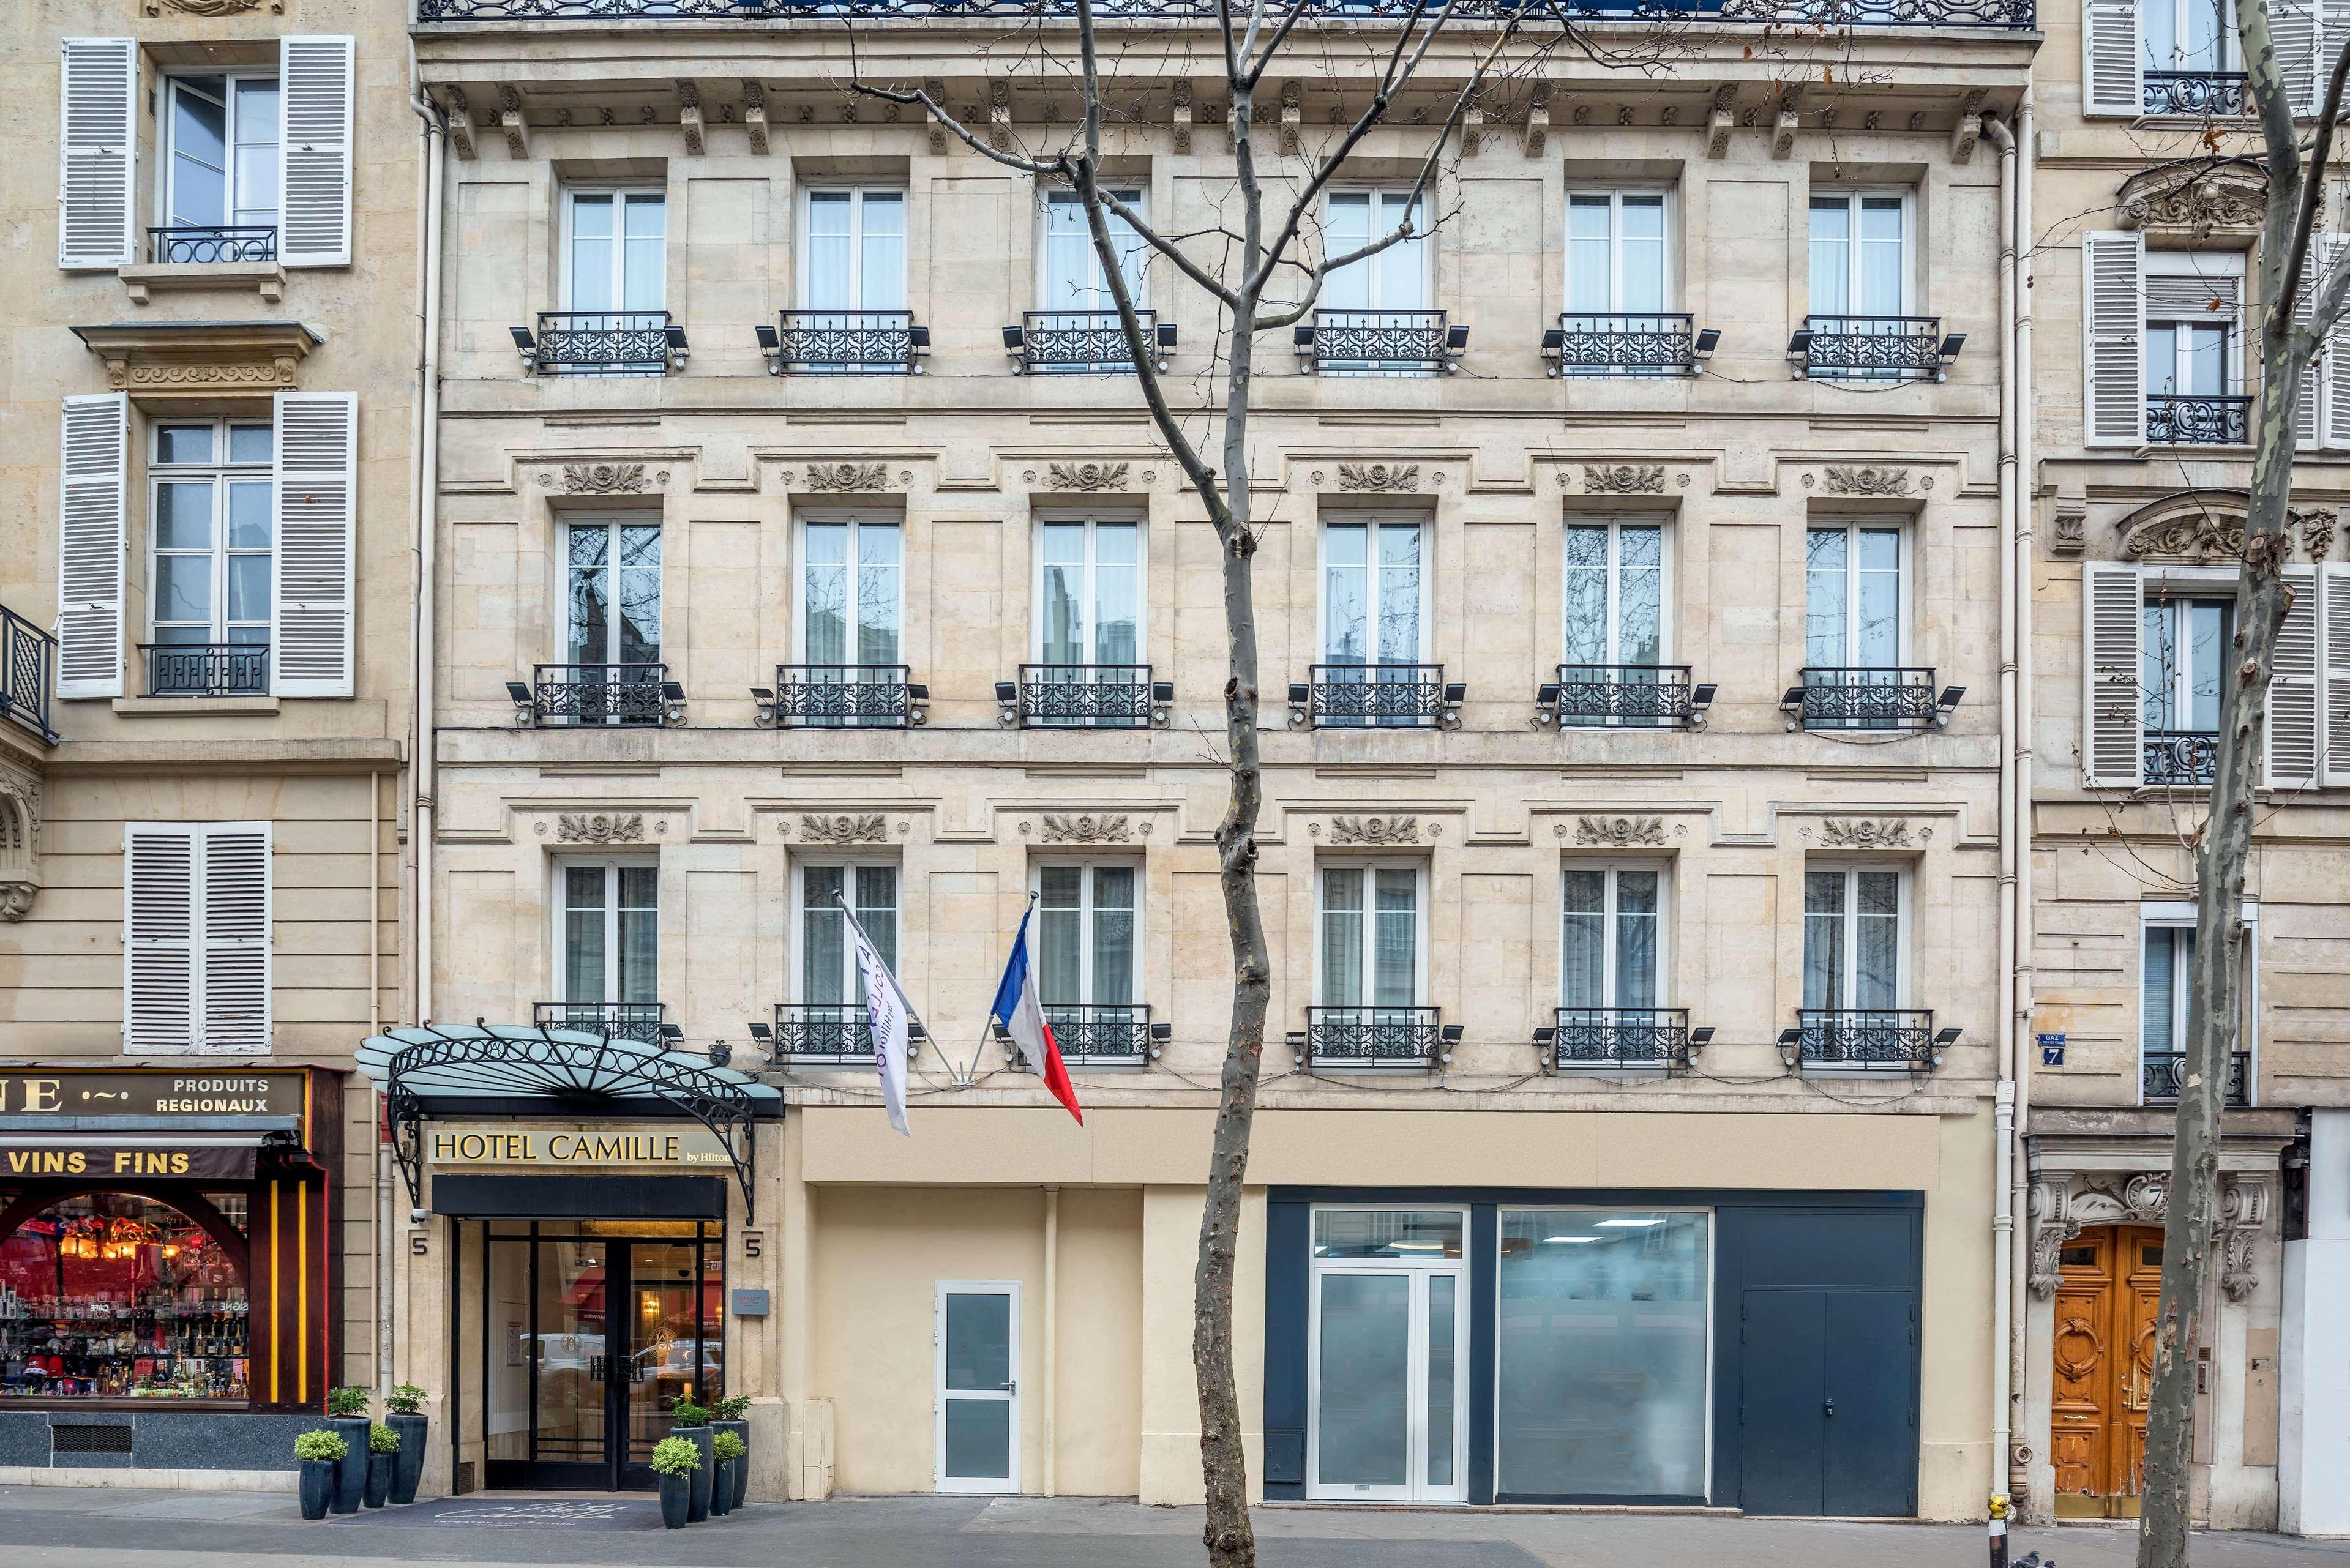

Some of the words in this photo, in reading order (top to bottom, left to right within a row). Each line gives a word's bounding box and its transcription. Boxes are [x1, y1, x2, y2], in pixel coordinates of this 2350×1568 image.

[2049, 1048, 2059, 1064] 7
[174, 1079, 269, 1092] PRODUITS
[0, 1079, 63, 1112] E
[156, 1099, 268, 1112] REGIONAUX
[435, 1134, 538, 1160] HOTEL
[548, 1135, 679, 1160] CAMILLE
[686, 1152, 699, 1164] by
[700, 1152, 732, 1162] Hilton
[8, 1152, 86, 1173] VINS
[114, 1152, 189, 1174] FINS
[2149, 1188, 2162, 1206] 7
[413, 1237, 427, 1255] 5
[746, 1239, 760, 1257] 5
